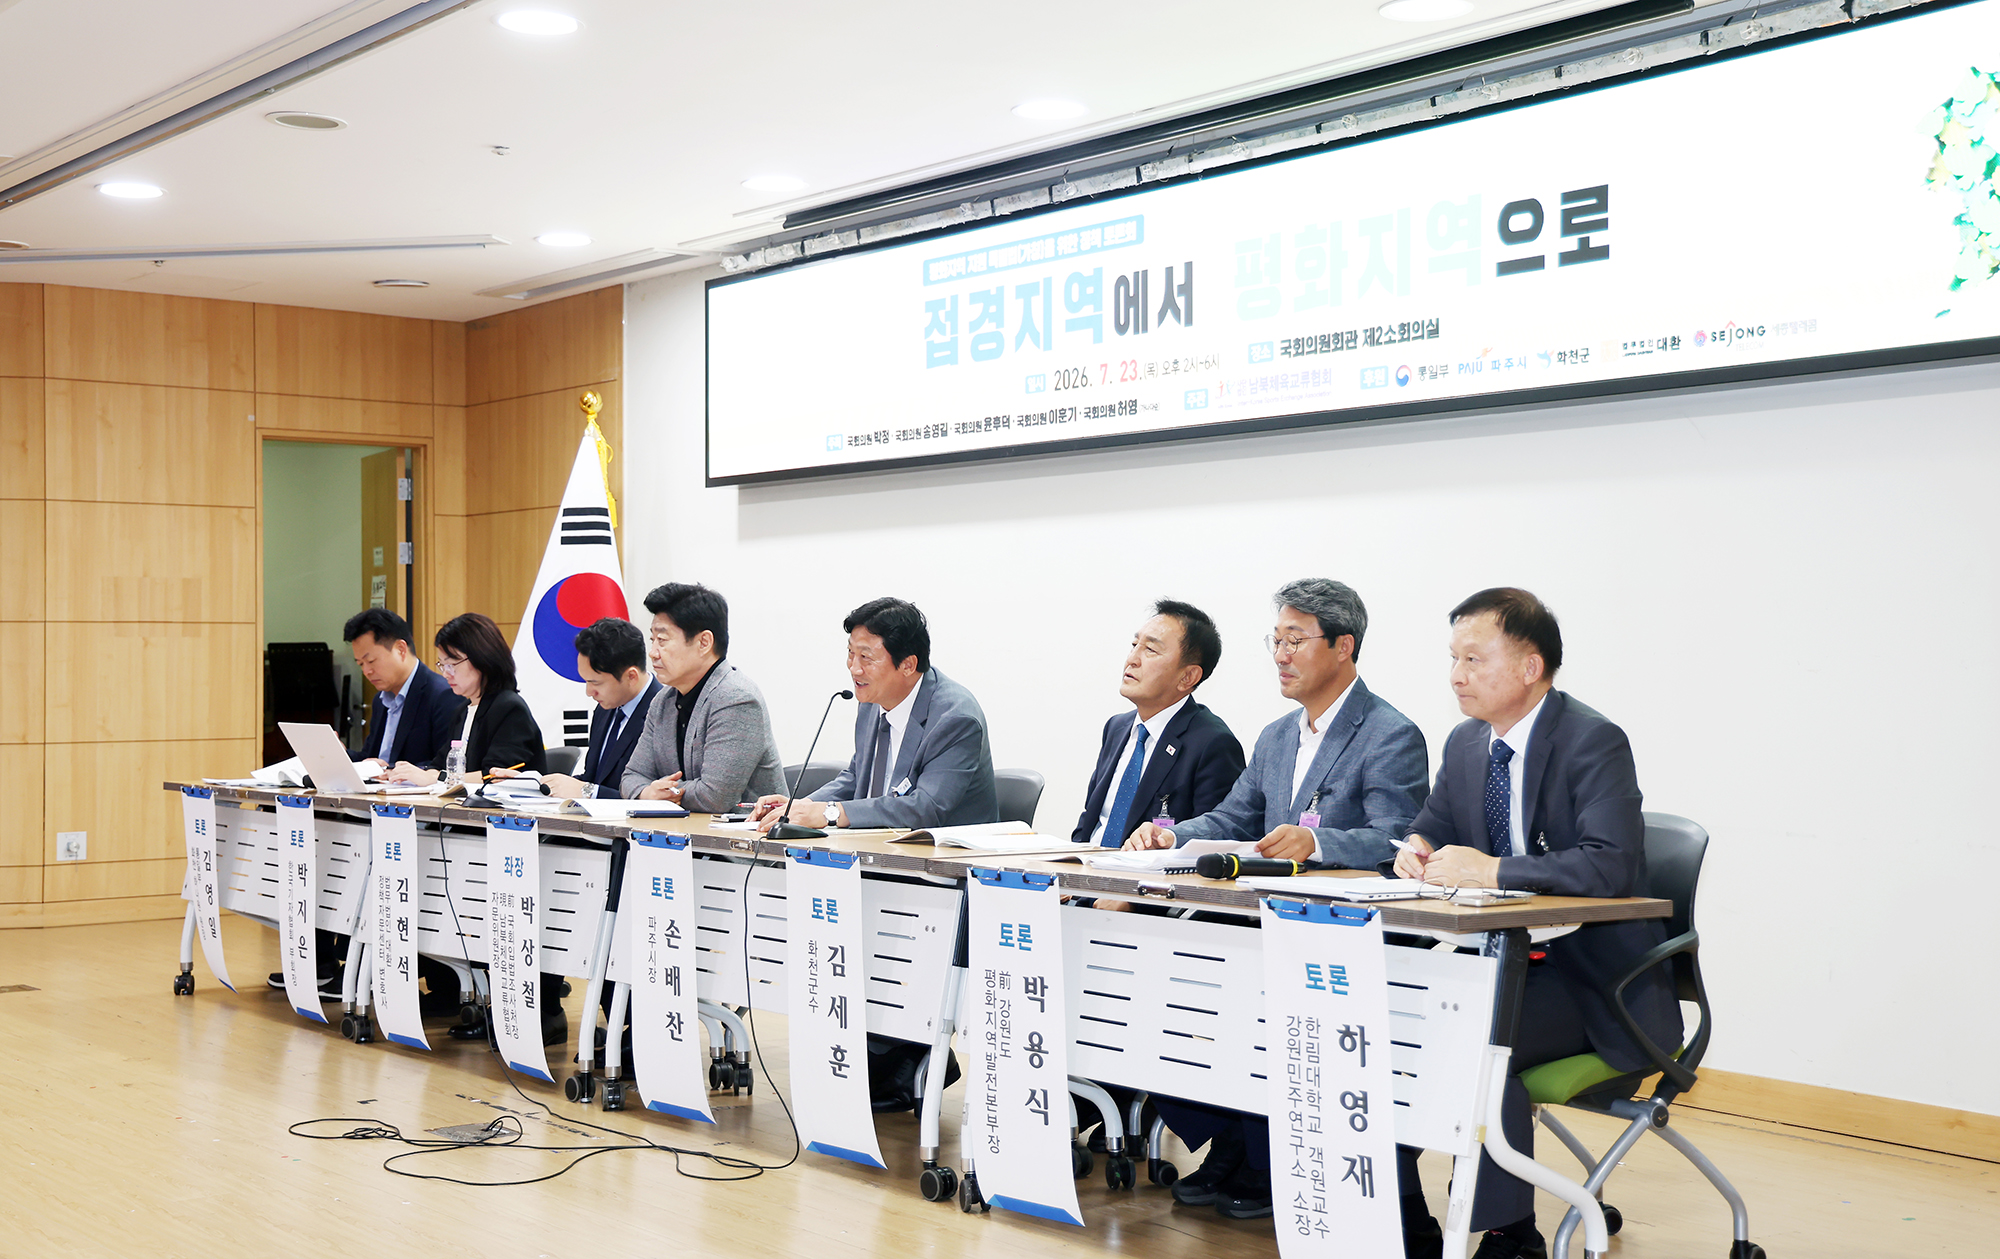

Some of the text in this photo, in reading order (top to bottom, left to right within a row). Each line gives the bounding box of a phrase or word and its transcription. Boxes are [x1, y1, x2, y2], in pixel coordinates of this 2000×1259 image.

[924, 184, 1610, 370] 접경지역에서 평화지역으로
[1249, 343, 1273, 362] 장소
[1280, 318, 1440, 359] 국회의원회관 제2소회의실
[1557, 348, 1590, 365] 화천군
[1657, 335, 1681, 352] 대환
[1711, 325, 1766, 347] SEJONG
[1054, 368, 1093, 391] 2026.
[1100, 364, 1113, 386] 7.
[1162, 359, 1180, 375] 오후
[1249, 367, 1332, 395] 남북체육교류협회
[1363, 368, 1386, 387] 후원
[1418, 364, 1449, 381] 통일부
[1186, 390, 1207, 409] 주관
[847, 433, 873, 447] 국회의원
[874, 429, 890, 444] 박정
[895, 428, 922, 442] 국회의원
[923, 422, 948, 439] 송영길
[954, 420, 983, 435] 국회의원
[984, 415, 1011, 432] 윤후덕
[1016, 412, 1047, 428] 국회의원
[1048, 407, 1077, 425] 이훈기
[1083, 404, 1116, 420] 국회의원
[1117, 398, 1138, 417] 허영
[290, 830, 305, 848] 토론
[385, 842, 402, 862] 토론
[504, 856, 524, 878] 좌장
[651, 876, 675, 901] 토론
[297, 863, 308, 959] 박지은
[396, 877, 409, 983] 김현석
[811, 897, 839, 924] 토론
[520, 896, 535, 1009] 박상철
[648, 916, 657, 984] 파주시장
[999, 922, 1034, 952] 토론
[507, 913, 520, 1040] 국회입법조사처장
[664, 918, 684, 1043] 손배찬
[808, 939, 819, 1013] 화천군수
[1305, 962, 1350, 996] 토론
[827, 945, 850, 1080] 김세훈
[999, 970, 1012, 1059] 前 강원도
[984, 968, 1001, 1155] 평화지역발전본부장
[1023, 975, 1050, 1126] 박용식
[1286, 1015, 1311, 1236] 강원민주연구소 소장
[1305, 1016, 1331, 1239] 한림대학교 객원교수
[1336, 1023, 1375, 1199] 하영재
